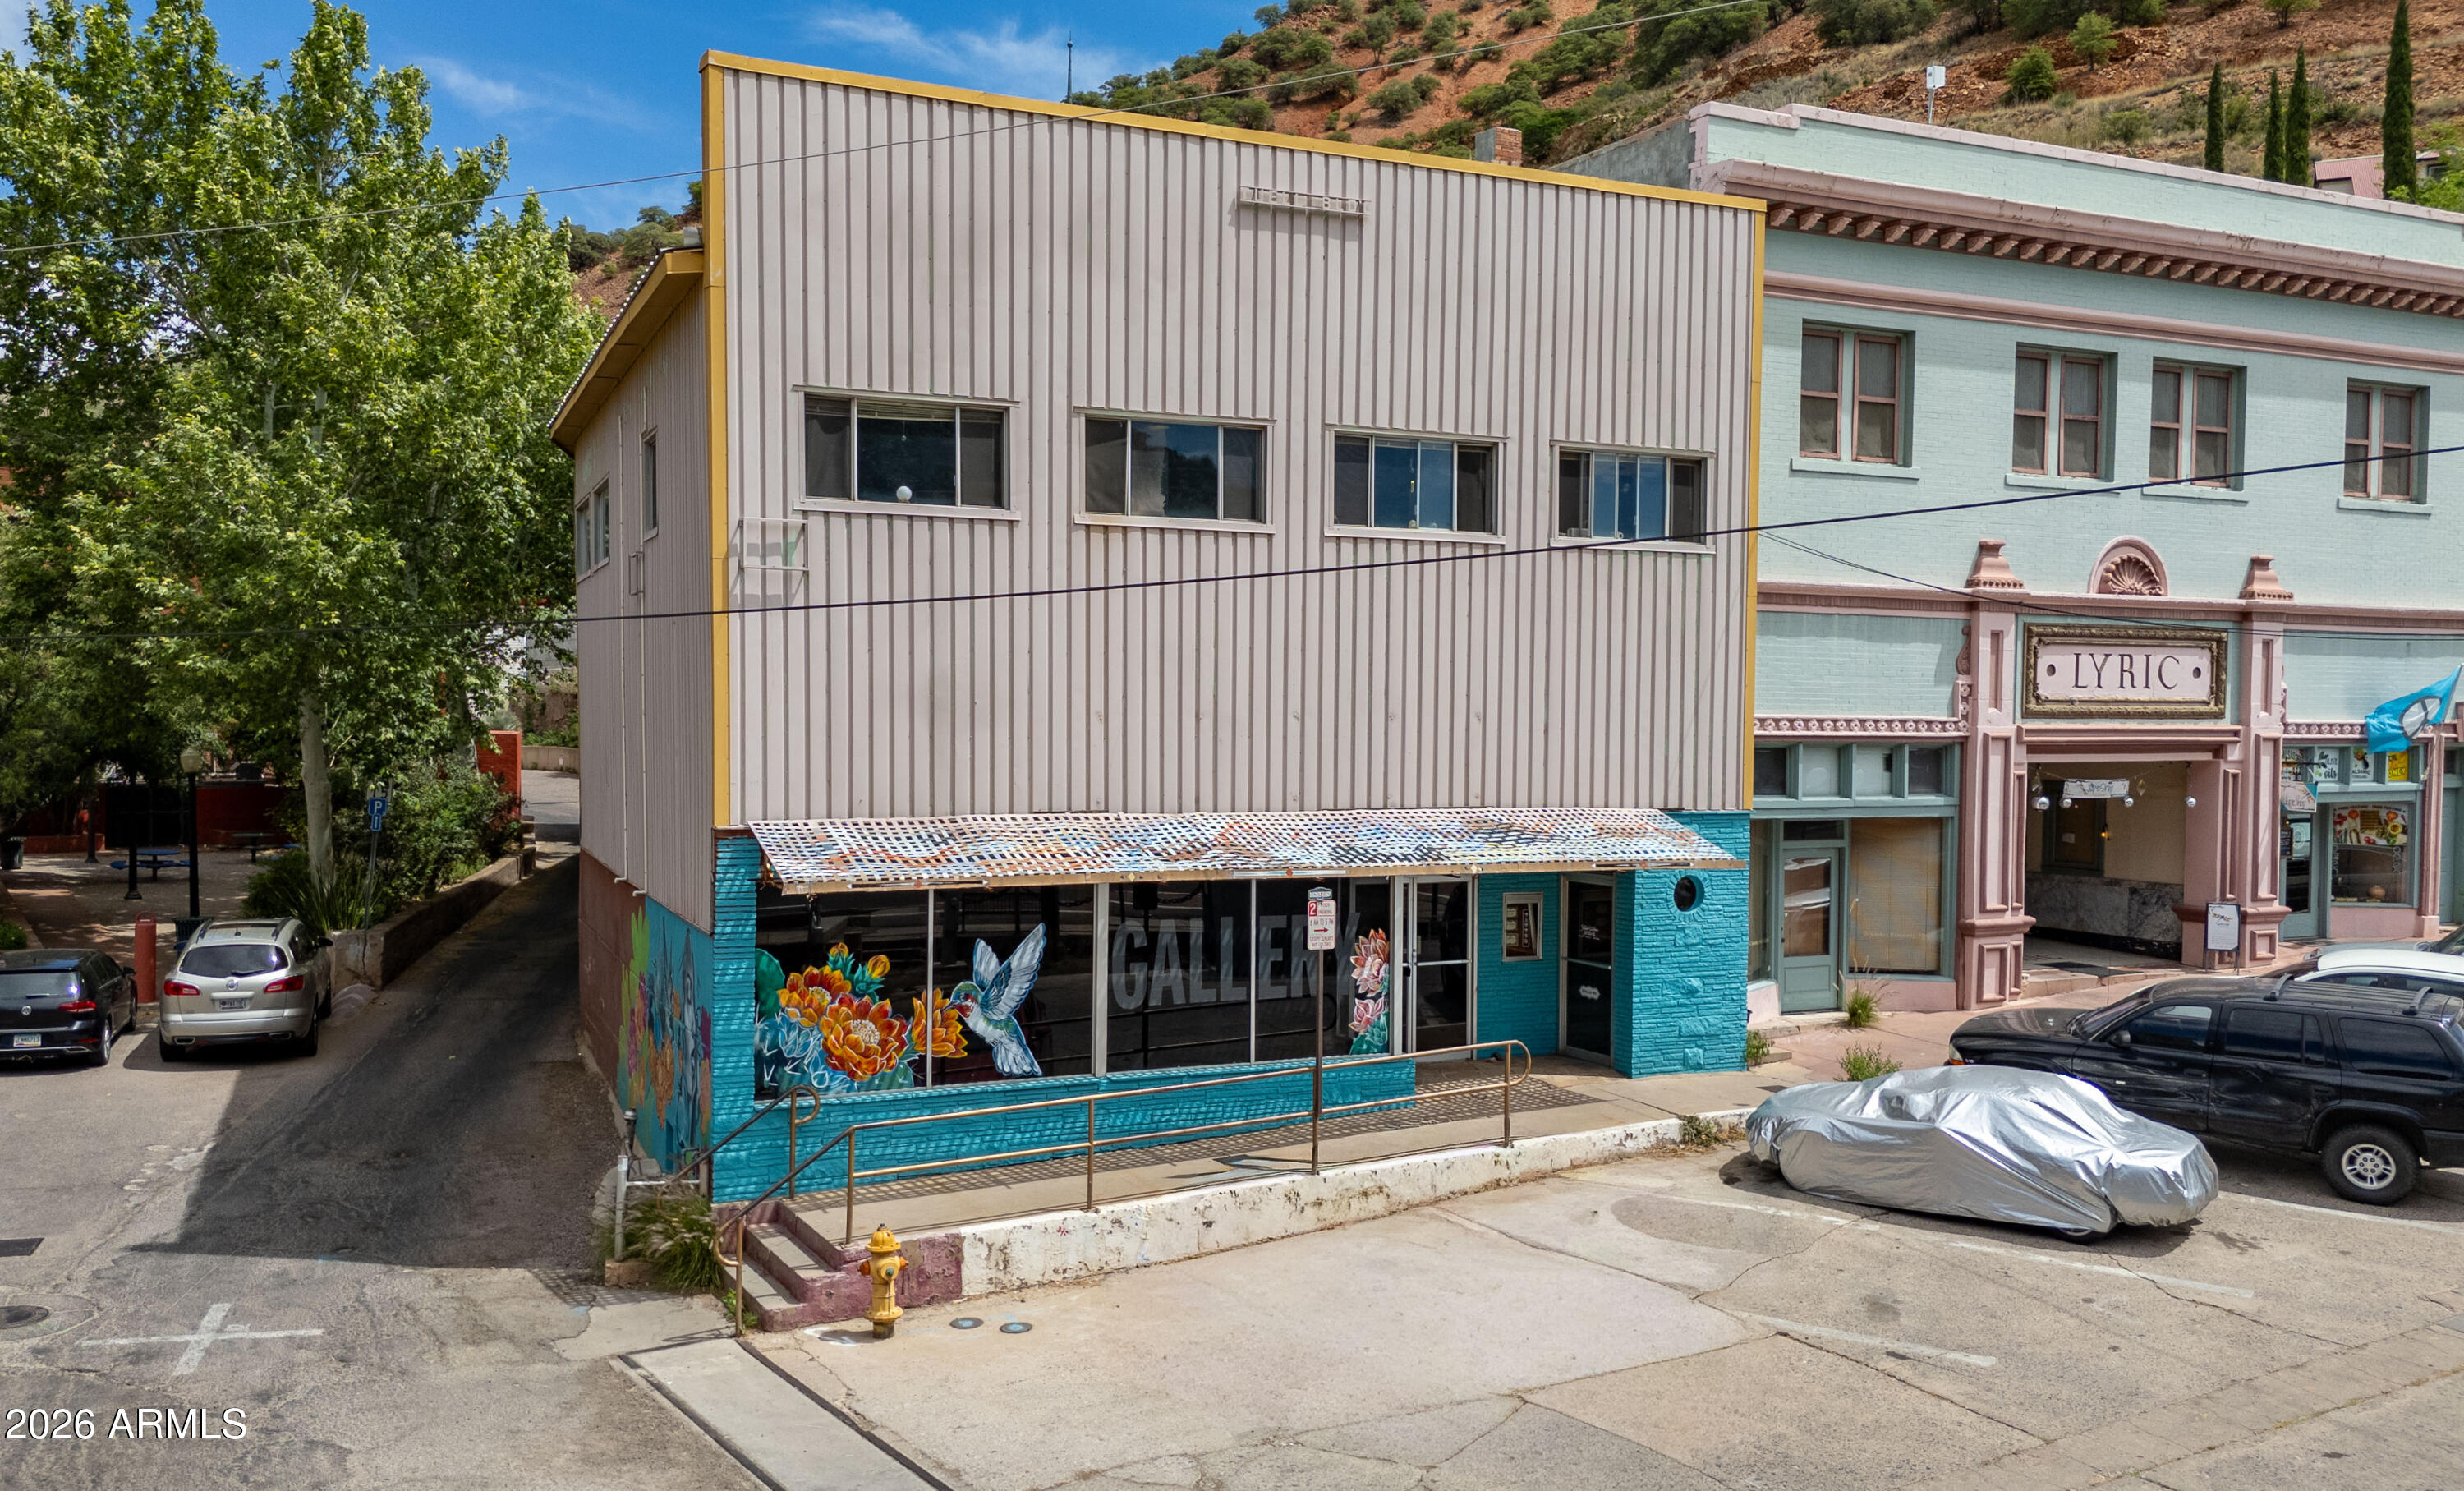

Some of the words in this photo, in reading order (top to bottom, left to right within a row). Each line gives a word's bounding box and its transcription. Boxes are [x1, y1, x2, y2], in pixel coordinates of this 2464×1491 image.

[2071, 653, 2180, 690] LYRIC
[374, 800, 383, 815] P
[1309, 903, 1316, 915] 2
[1111, 913, 1360, 1010] GALLERY
